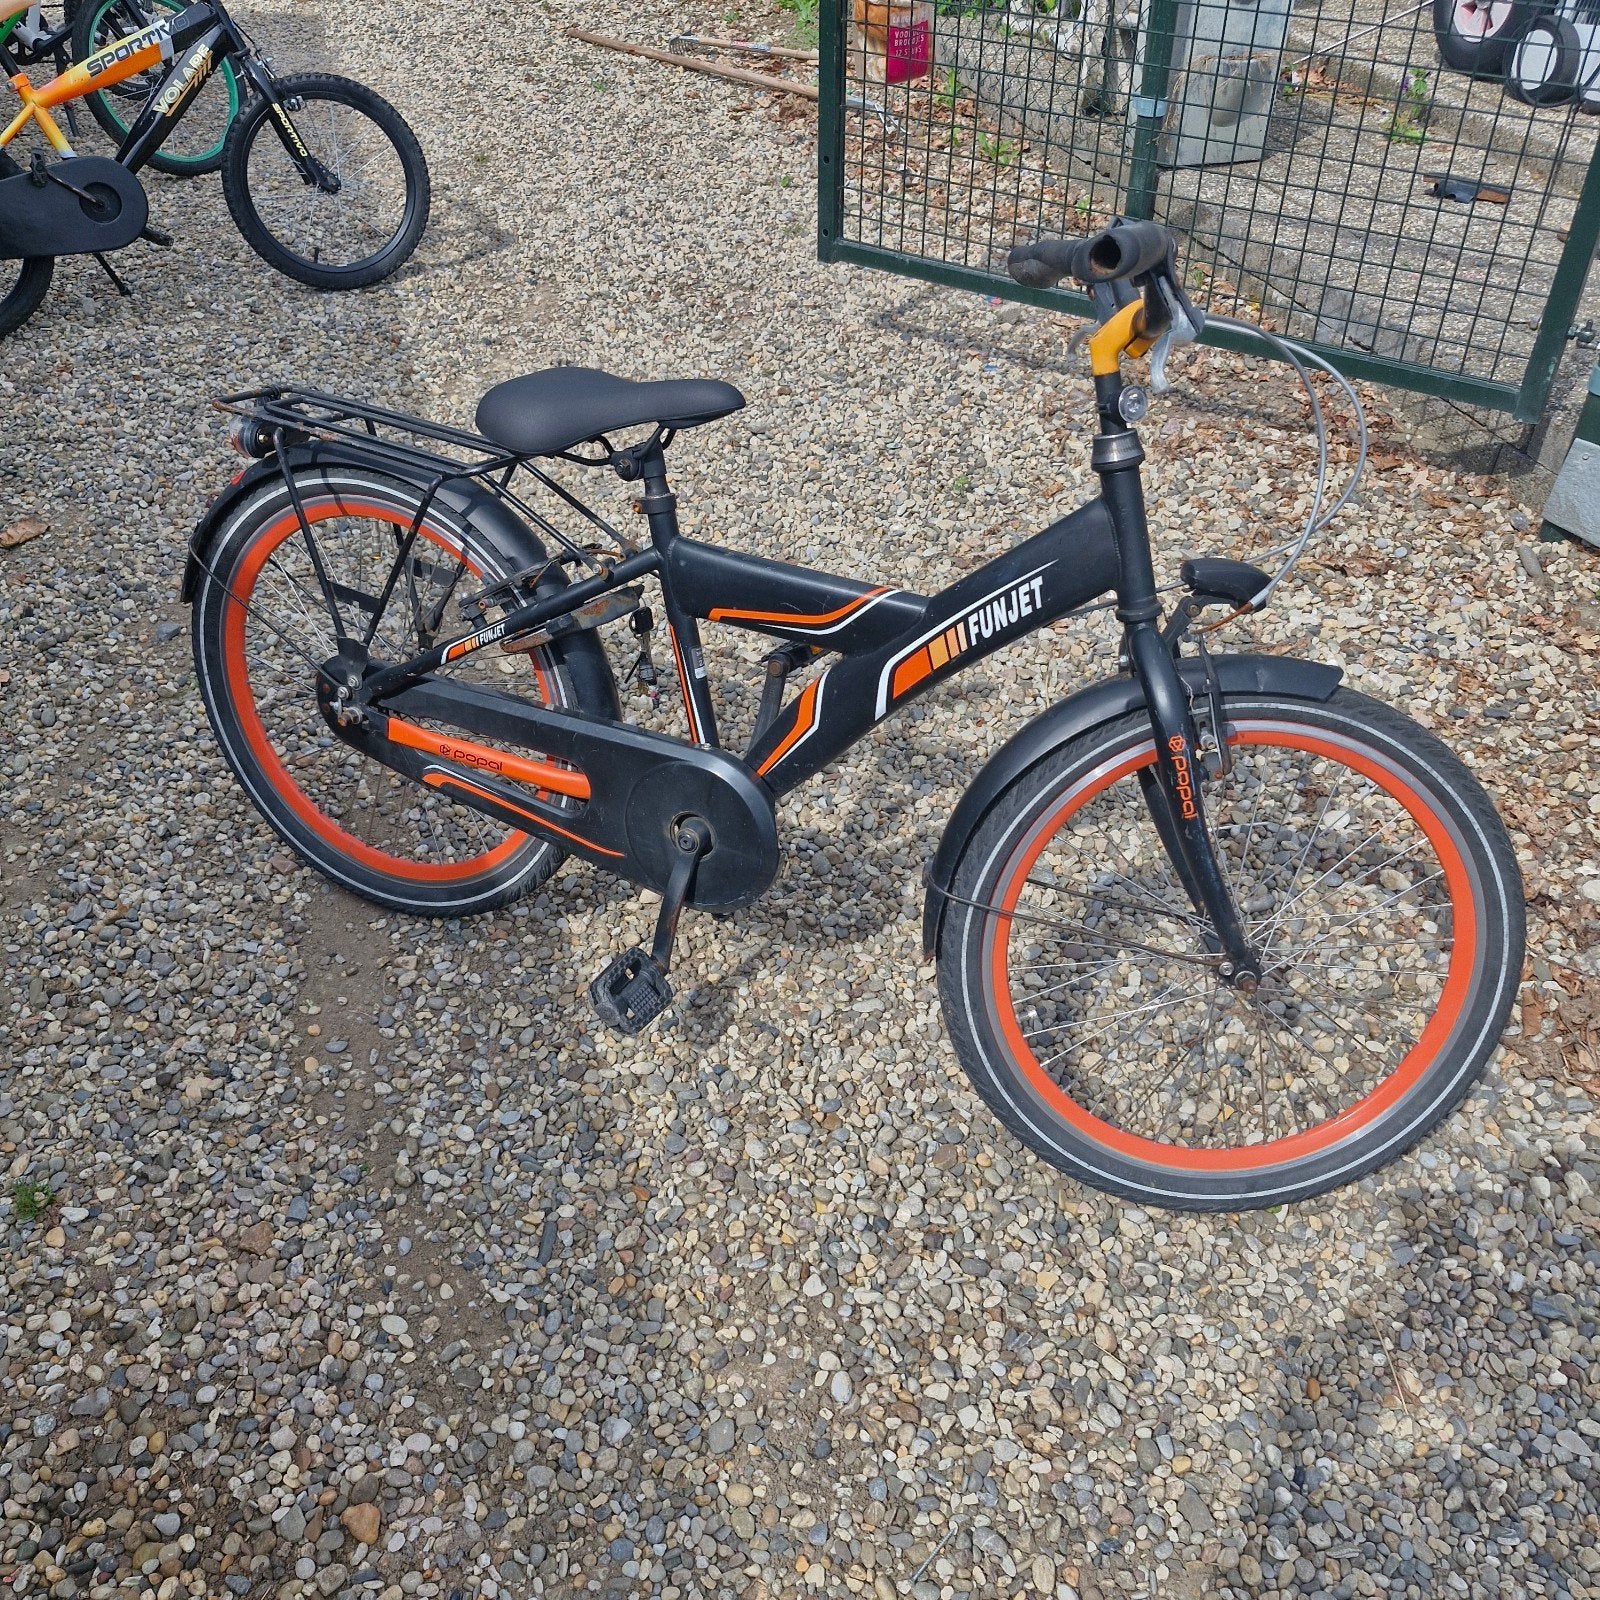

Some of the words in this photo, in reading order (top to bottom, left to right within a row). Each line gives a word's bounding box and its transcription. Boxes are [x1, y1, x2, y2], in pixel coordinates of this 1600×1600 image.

[86, 15, 190, 77] SPORTIVO
[152, 43, 210, 113] VOLARE
[271, 102, 308, 157] SPORTIVO
[479, 623, 506, 645] FUNJET
[967, 575, 1043, 647] FUNJET
[453, 749, 503, 771] popal
[1170, 755, 1199, 819] popal
